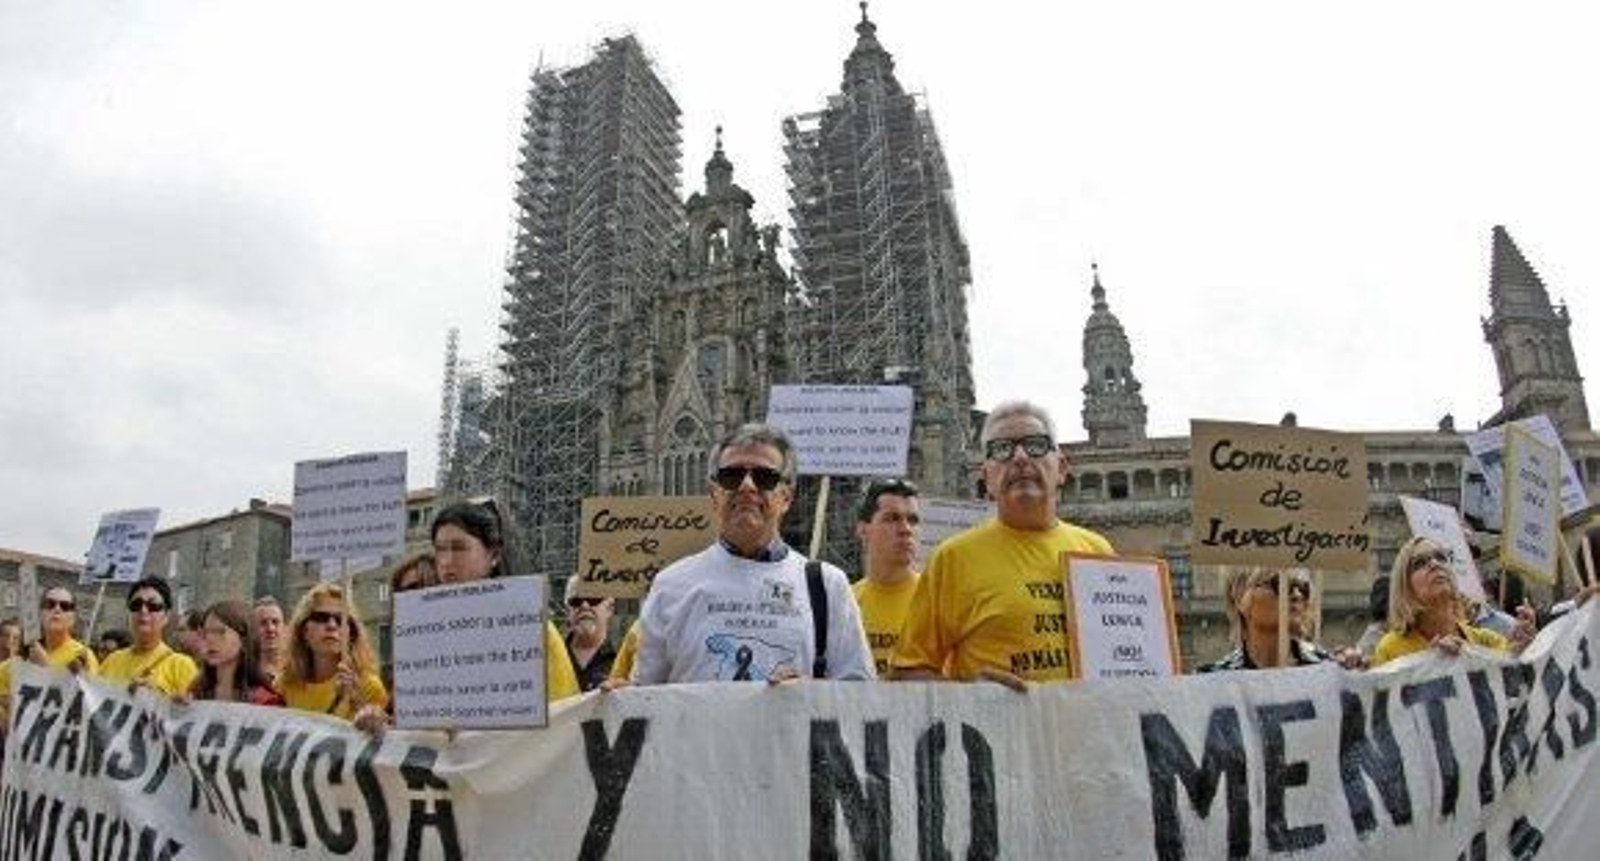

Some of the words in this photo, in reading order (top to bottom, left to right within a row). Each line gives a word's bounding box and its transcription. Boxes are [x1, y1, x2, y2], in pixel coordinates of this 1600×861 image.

[1259, 481, 1302, 510] de
[625, 536, 660, 554] de
[577, 718, 648, 861] Y
[809, 718, 999, 861] NO
